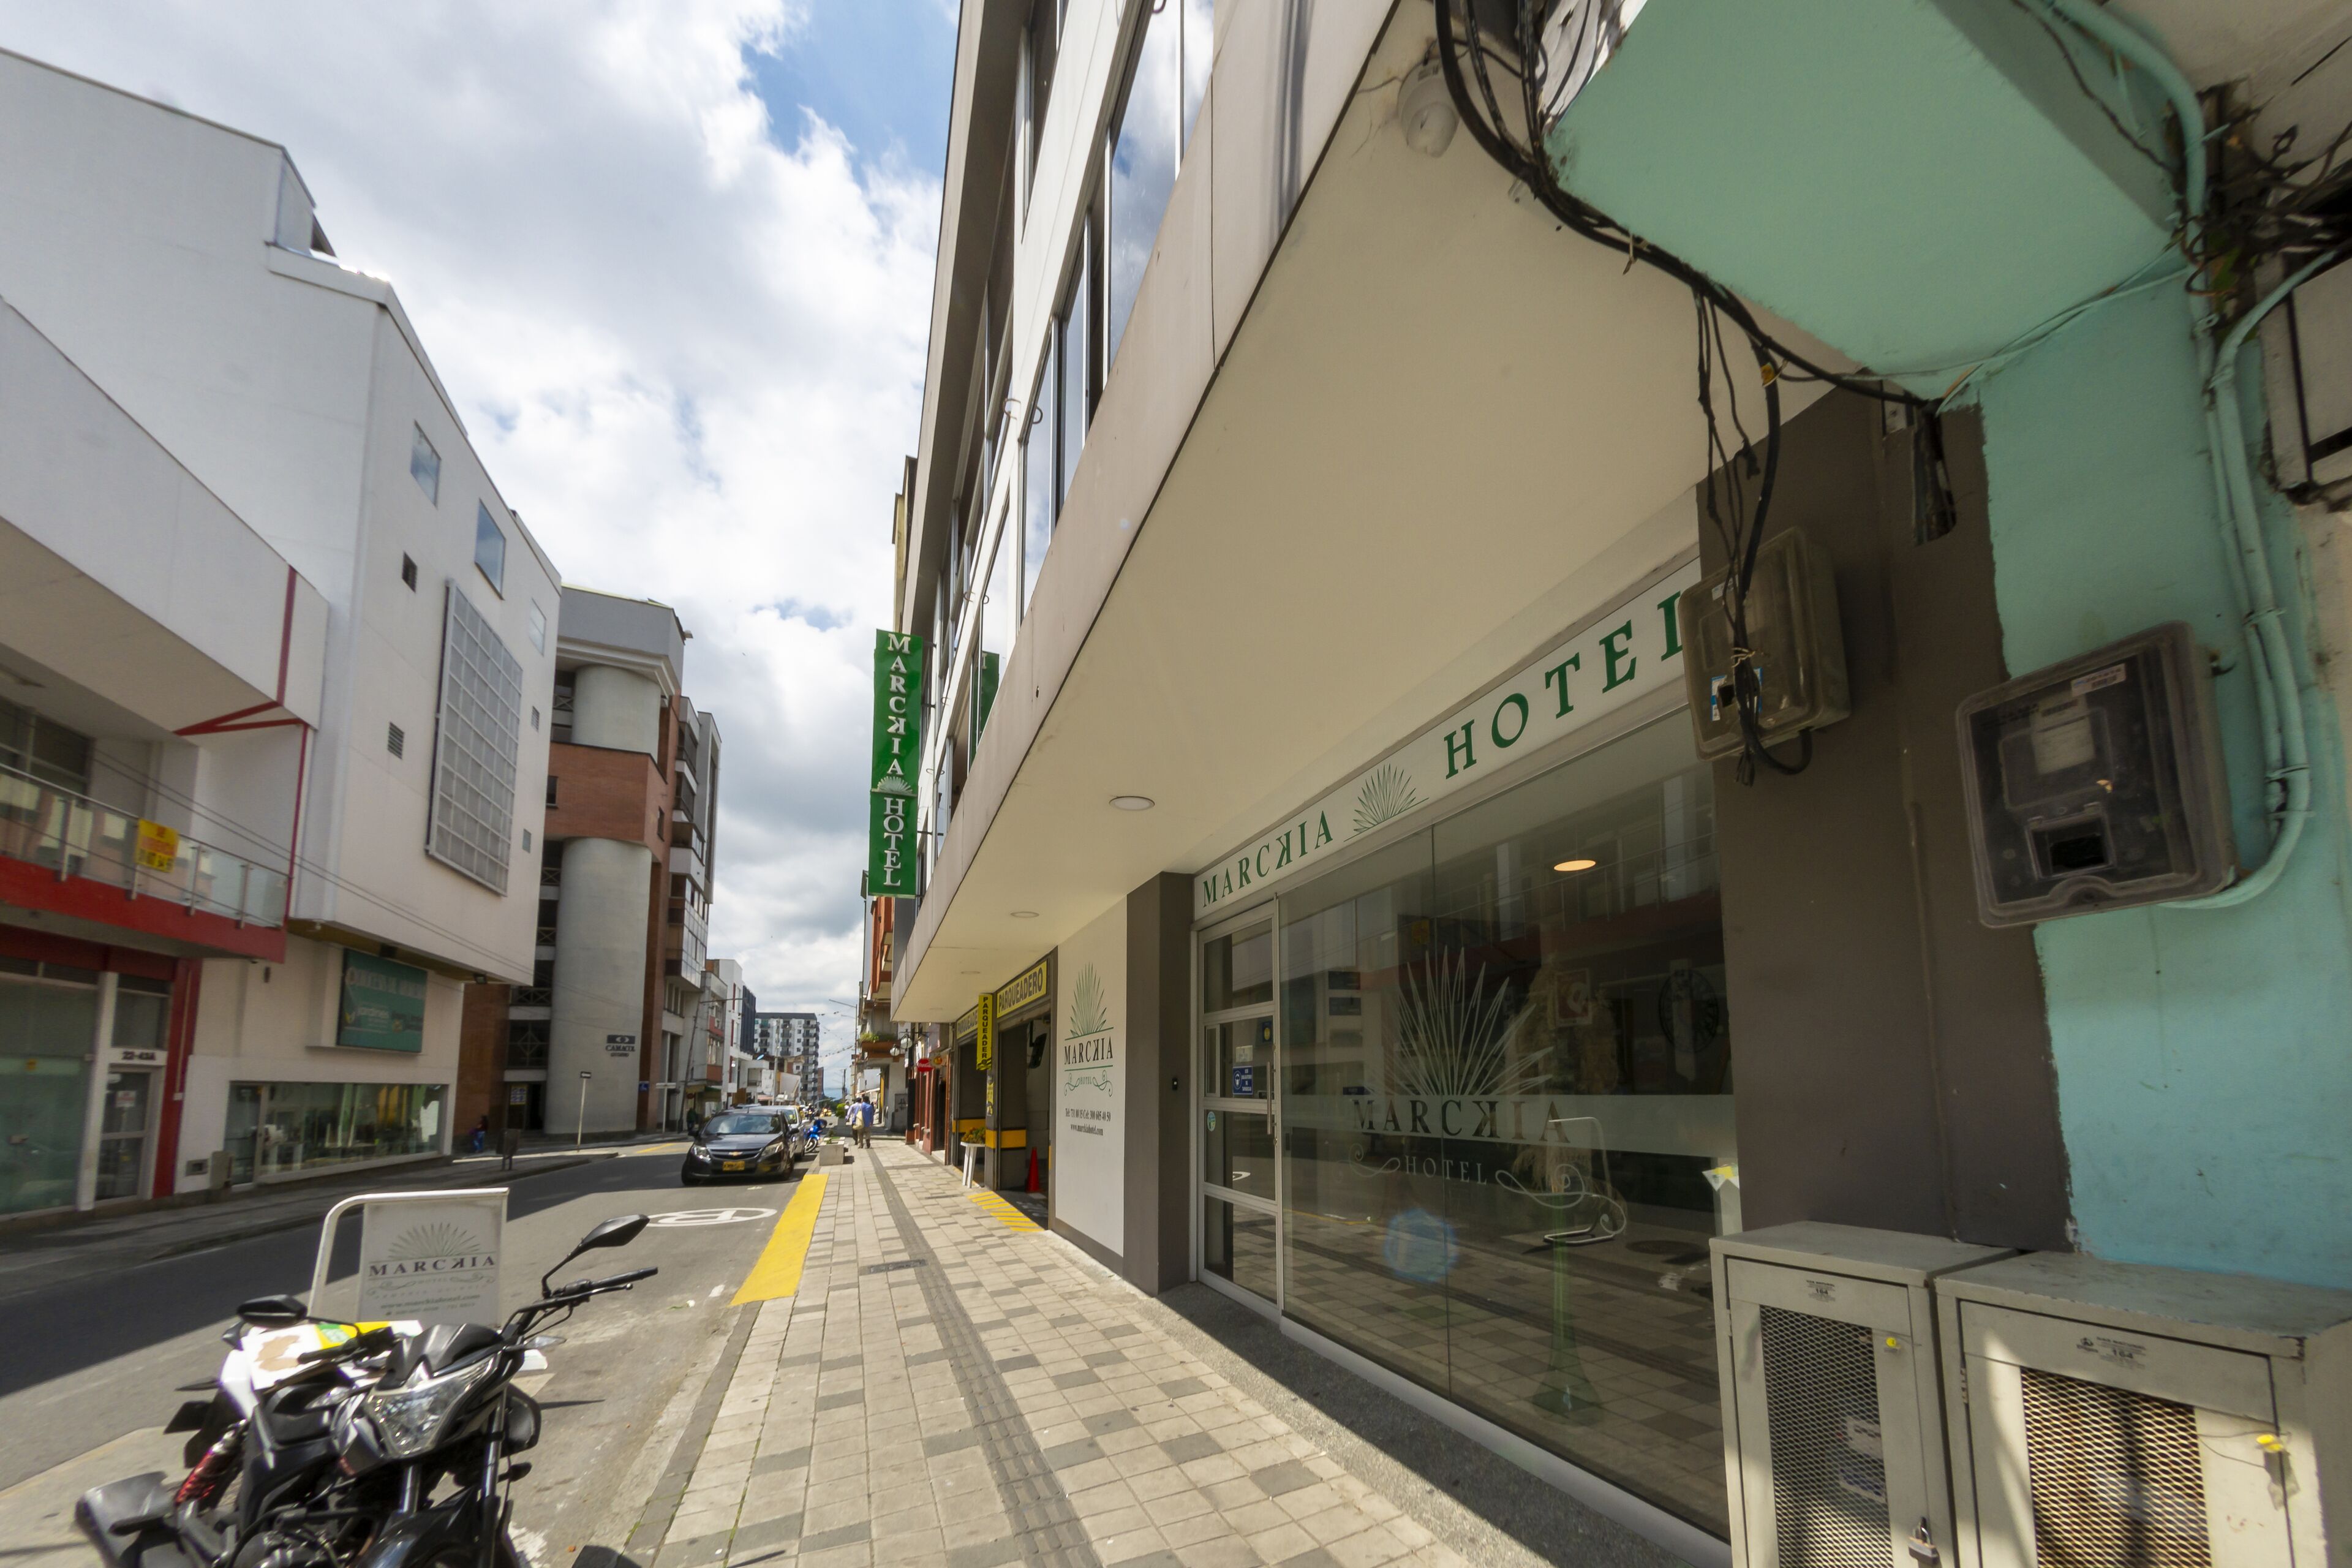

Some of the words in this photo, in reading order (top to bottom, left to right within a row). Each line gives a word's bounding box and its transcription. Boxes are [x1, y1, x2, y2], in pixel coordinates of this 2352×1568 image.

[888, 633, 911, 776] MARCKIA
[883, 797, 905, 886] HOTEL
[1203, 810, 1333, 908] MARCKIA
[998, 967, 1044, 1014] PARQUEADERO
[1065, 1036, 1114, 1065] MARCKIA
[1080, 1076, 1092, 1085] HOTEL
[1352, 1099, 1570, 1144] MARCKIA
[1406, 1155, 1487, 1185] HOTEL
[369, 1255, 496, 1277] MARCKIA
